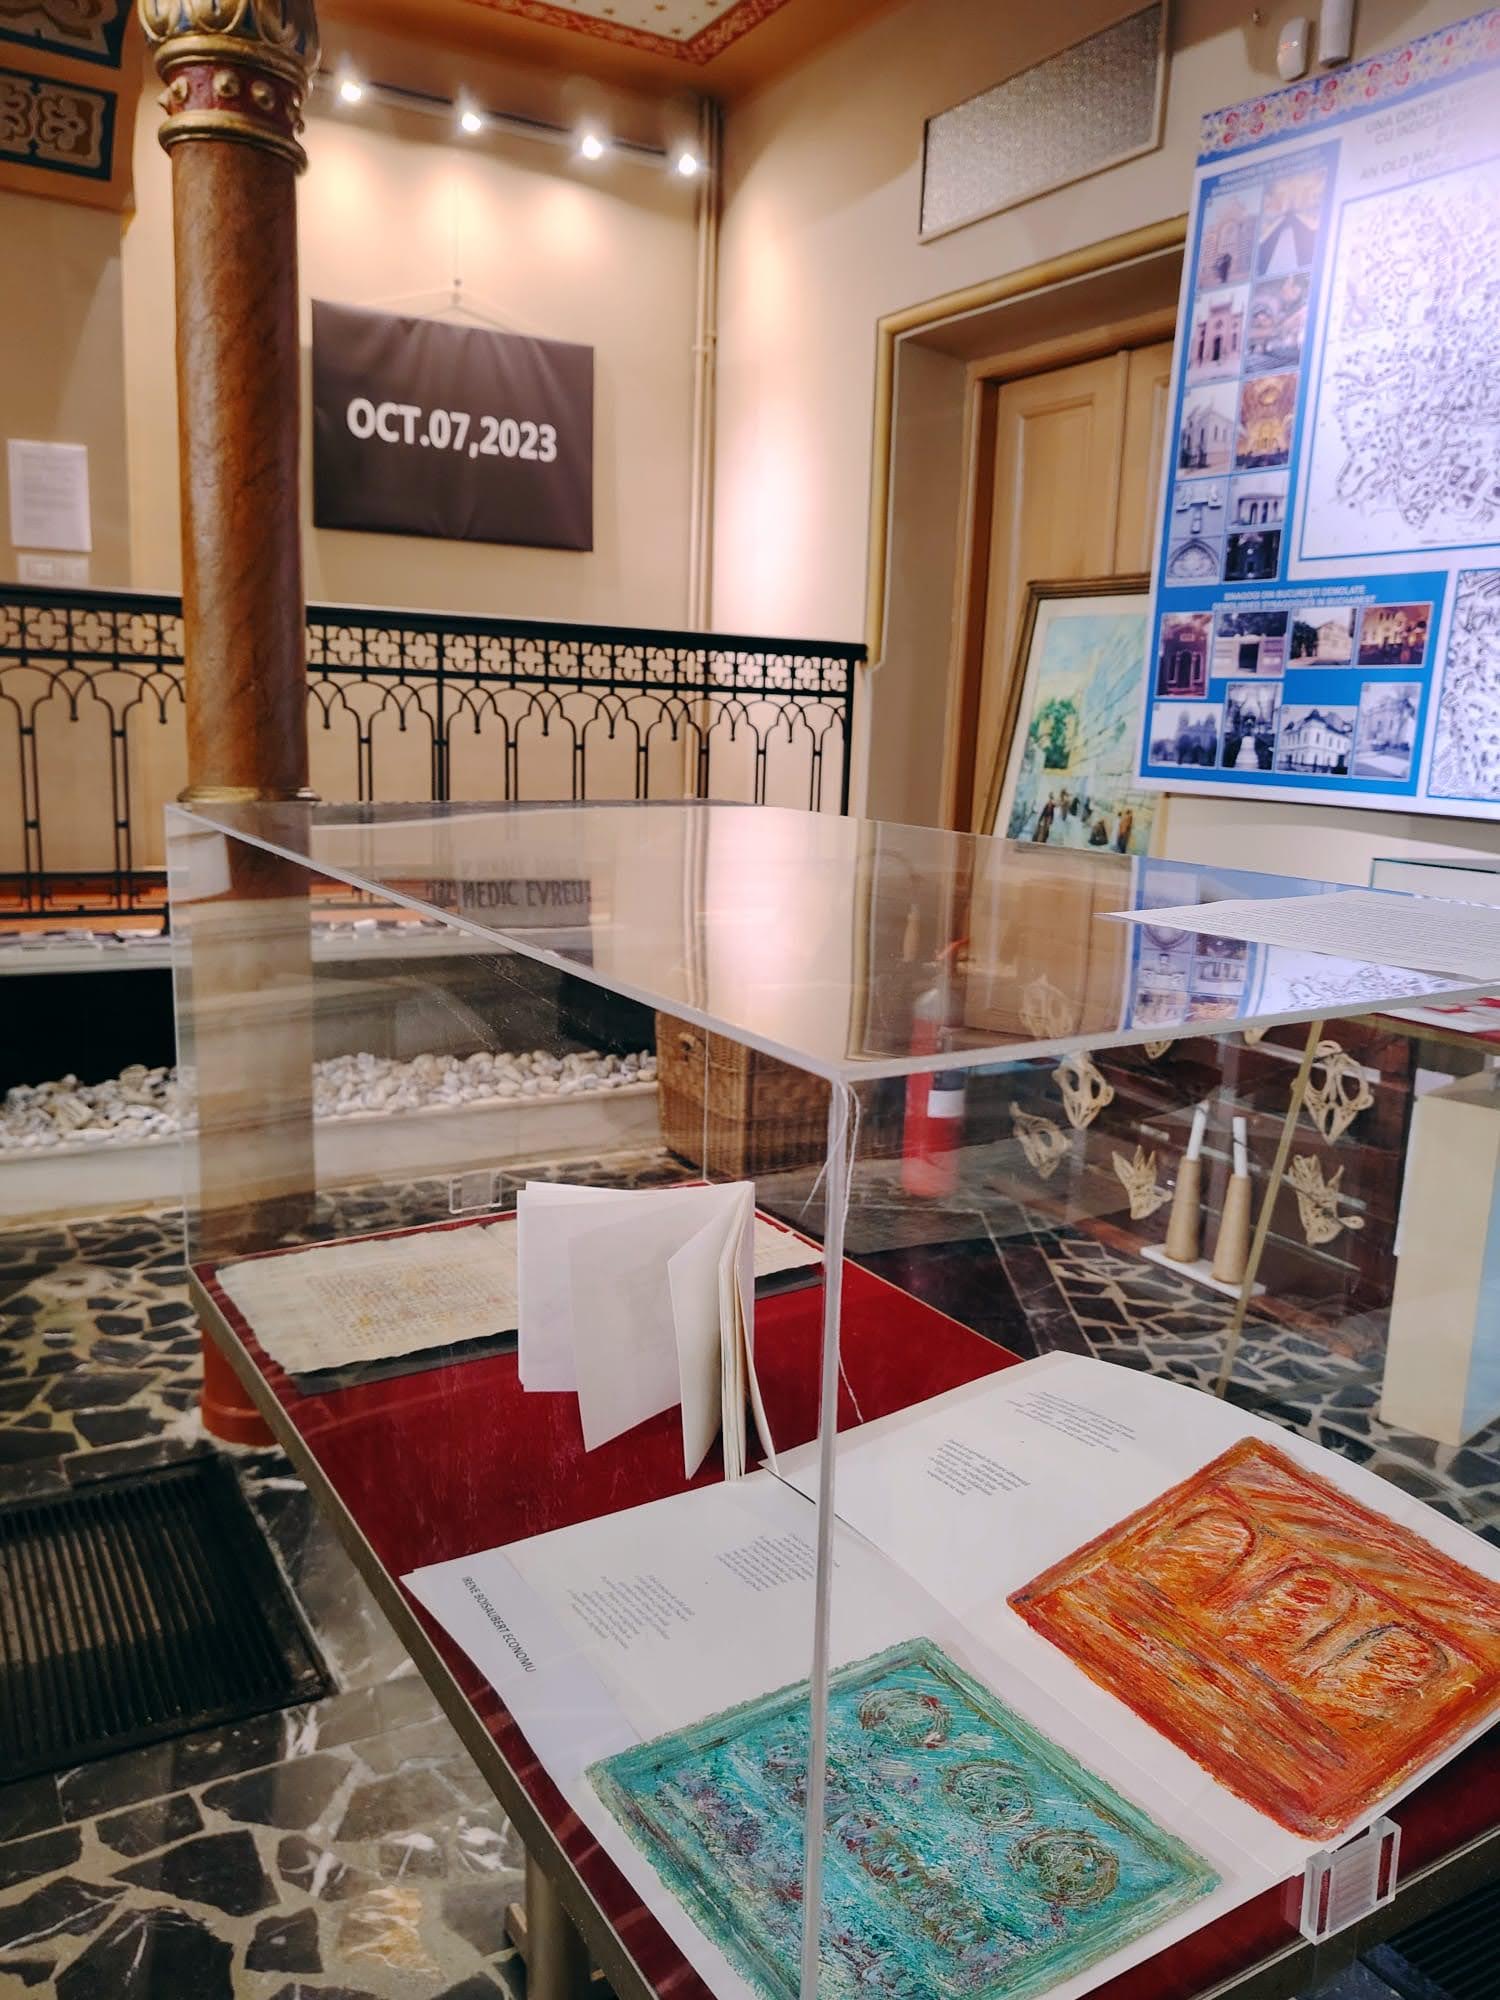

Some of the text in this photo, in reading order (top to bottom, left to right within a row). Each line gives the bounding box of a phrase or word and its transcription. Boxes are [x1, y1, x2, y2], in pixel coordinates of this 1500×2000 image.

[346, 397, 558, 463] OCT.07,2023
[462, 880, 519, 908] MEDIC
[502, 1633, 537, 1673] ECONOMU
